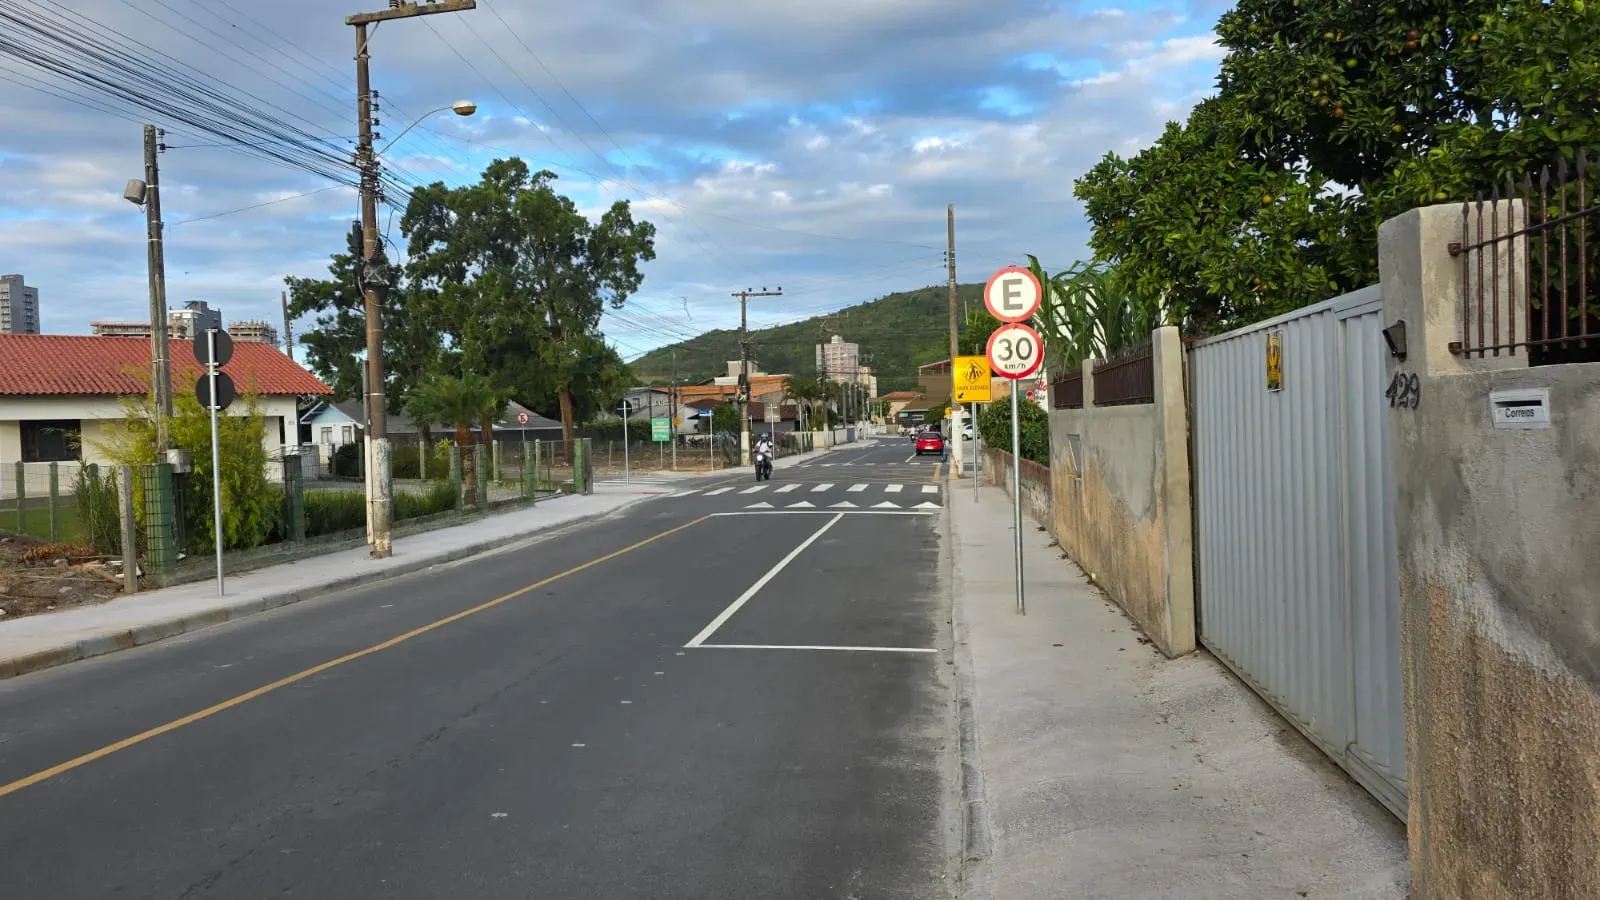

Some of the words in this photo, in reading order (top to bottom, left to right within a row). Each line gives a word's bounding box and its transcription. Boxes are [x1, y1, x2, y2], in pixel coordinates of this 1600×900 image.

[1002, 279, 1023, 310] E
[997, 337, 1033, 361] 30
[1004, 362, 1027, 370] km/h
[1505, 407, 1535, 418] Correios
